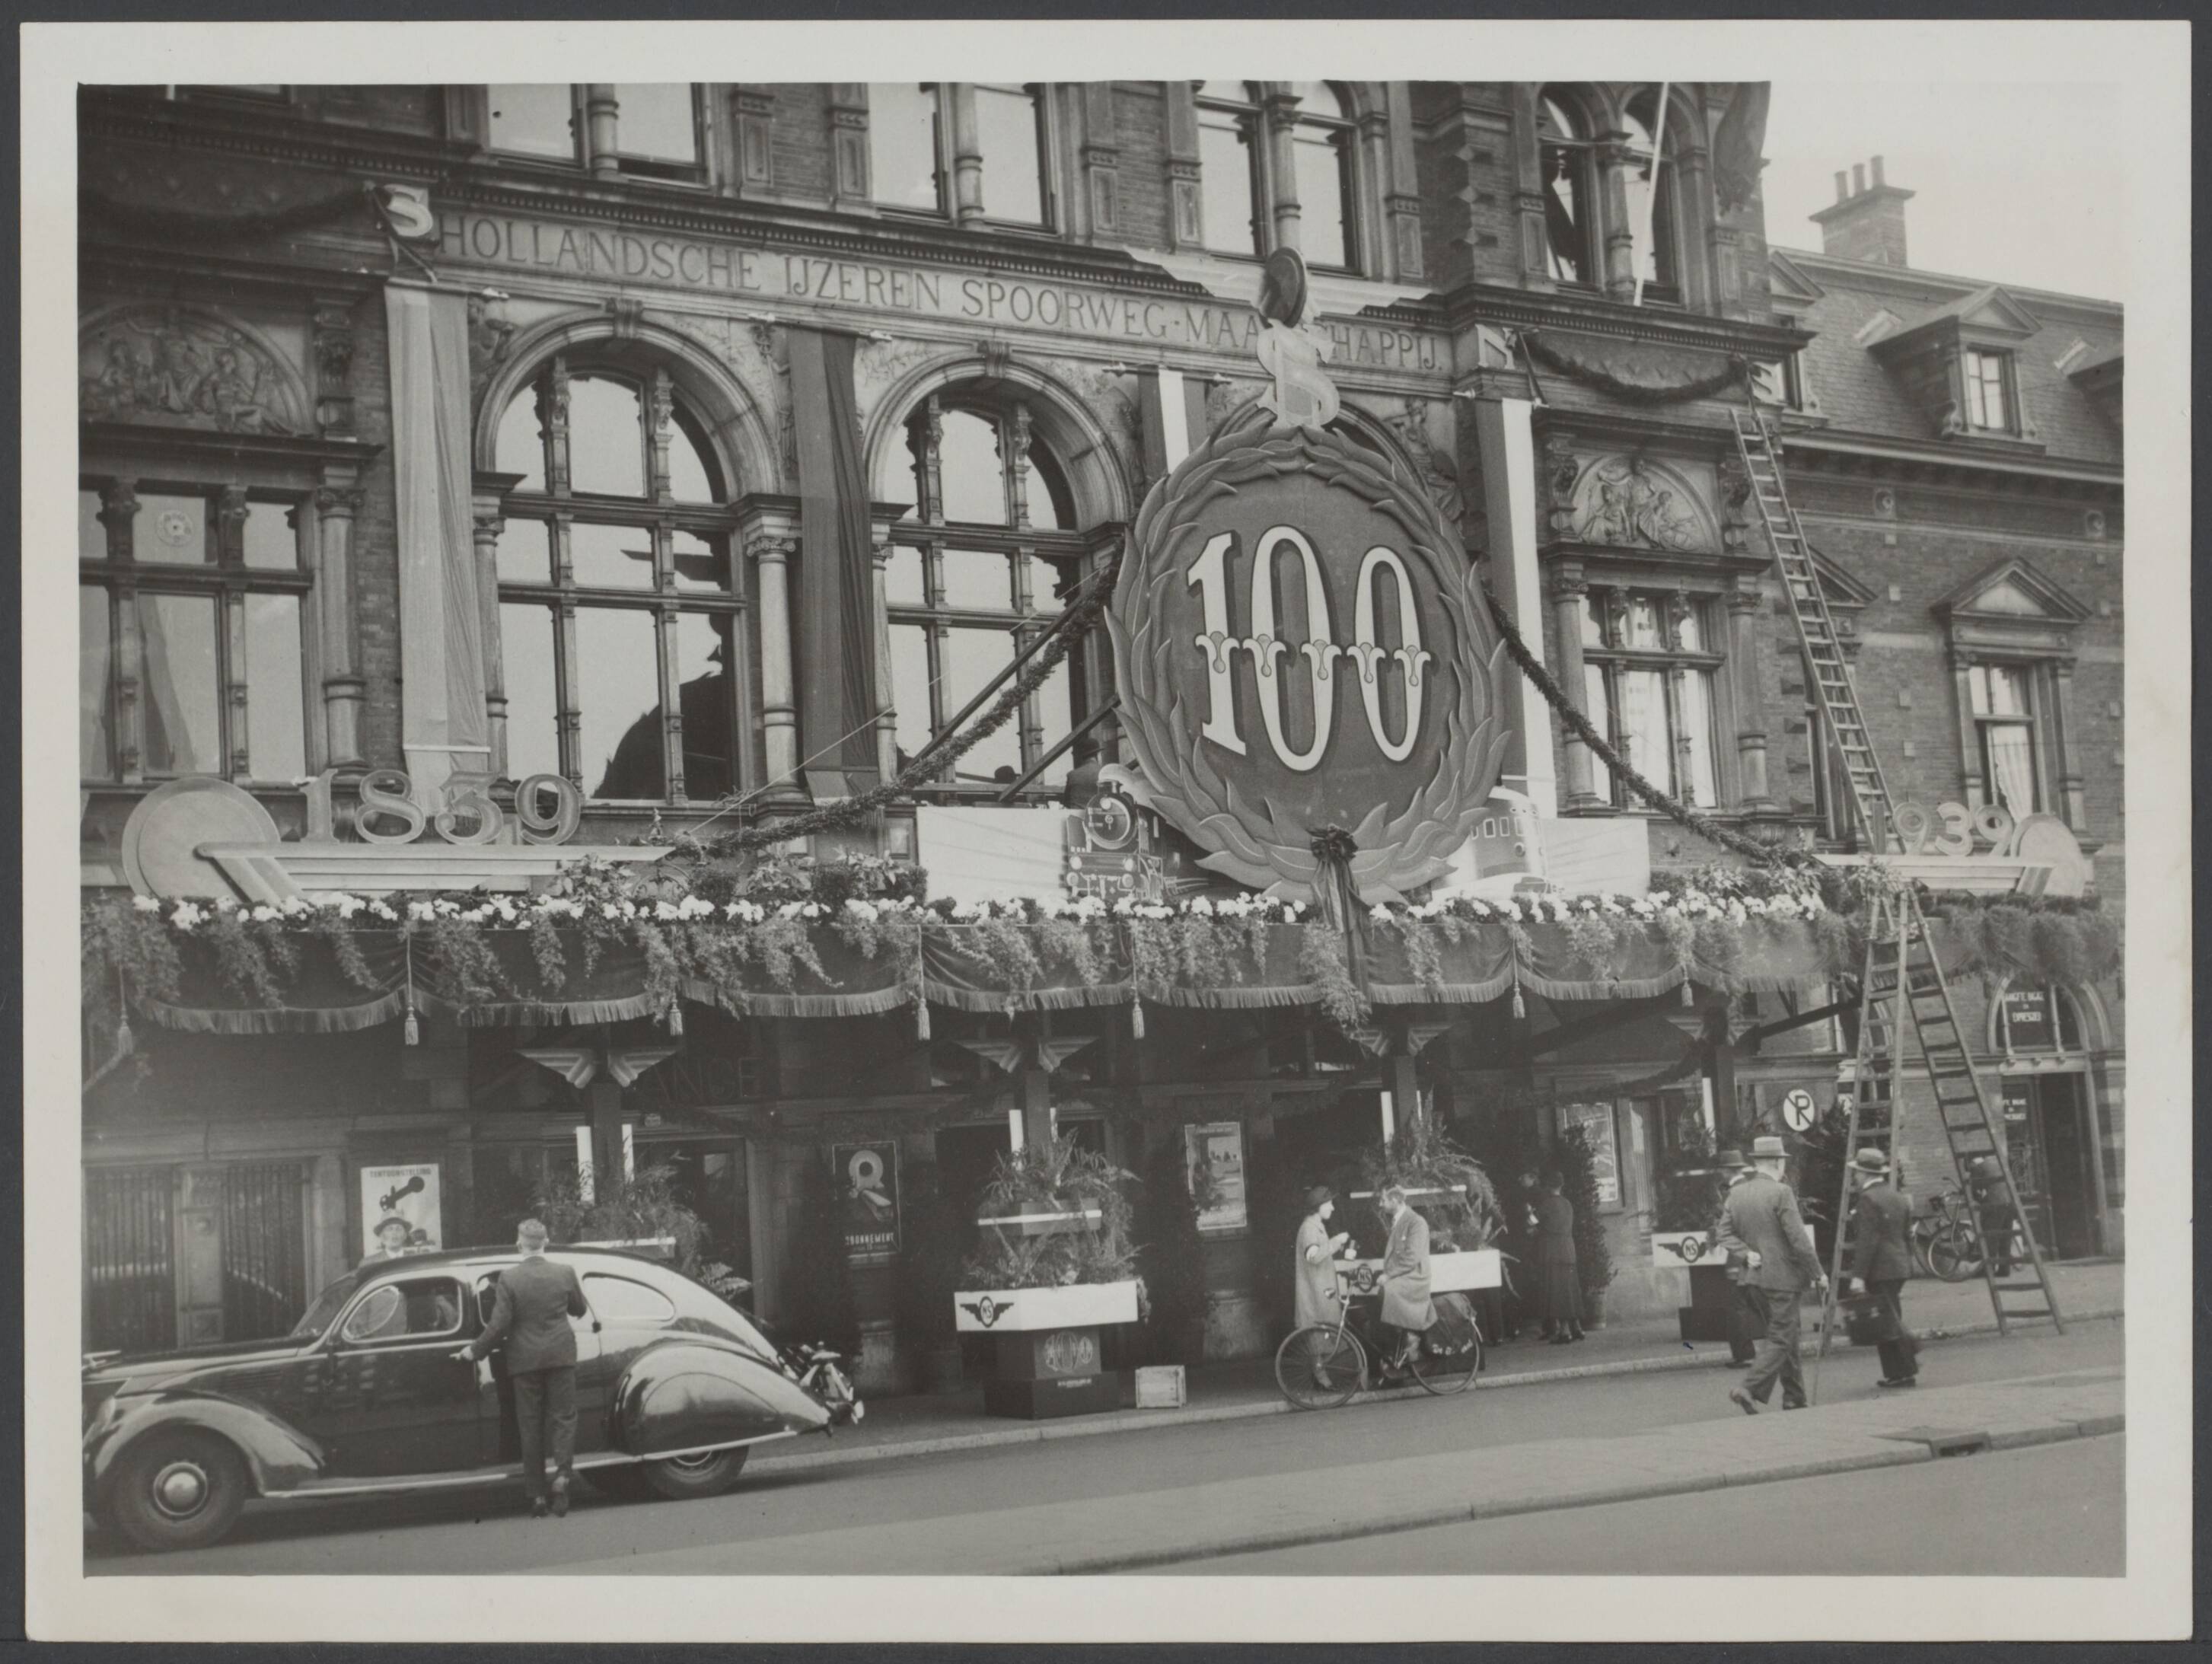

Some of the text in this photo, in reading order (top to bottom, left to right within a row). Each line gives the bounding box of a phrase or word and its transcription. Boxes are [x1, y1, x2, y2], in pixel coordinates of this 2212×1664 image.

[438, 213, 761, 292] HOLLANDSCHE
[785, 257, 942, 312] IJZEREN
[1187, 524, 1431, 772] 100
[299, 768, 581, 846] 1839
[1684, 1244, 1697, 1257] NS
[981, 1305, 993, 1320] NS
